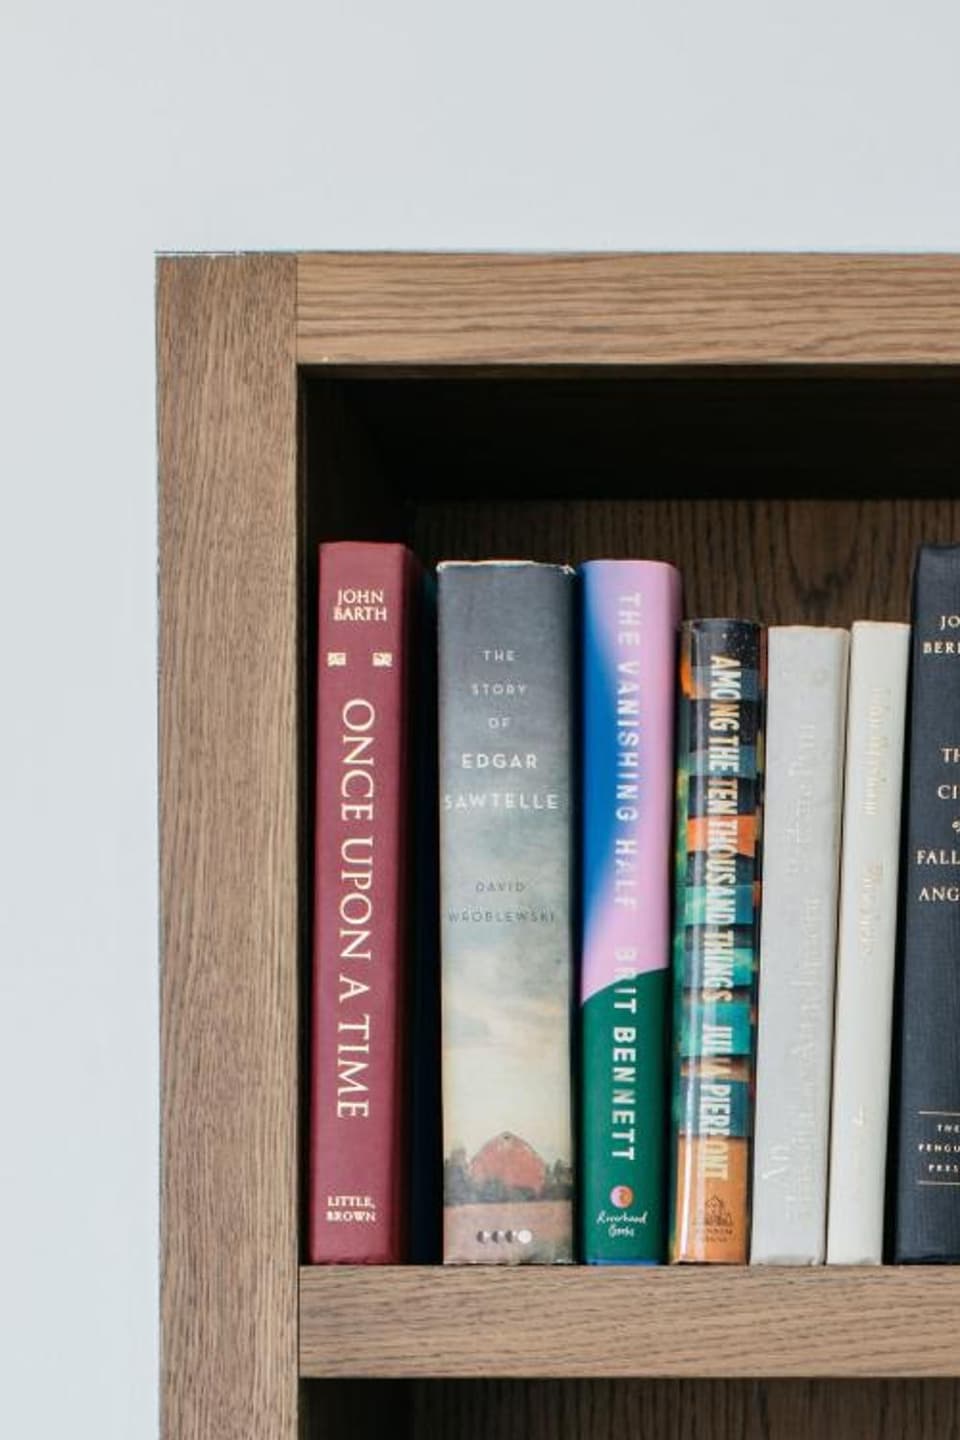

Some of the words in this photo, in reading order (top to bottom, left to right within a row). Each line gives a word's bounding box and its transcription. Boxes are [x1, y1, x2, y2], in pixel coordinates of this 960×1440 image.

[333, 606, 388, 622] BARTH
[336, 588, 385, 606] JOHN
[617, 592, 641, 647] THE
[481, 650, 516, 662] THE
[470, 683, 529, 697] STORY
[708, 655, 742, 731] AMONG
[487, 716, 513, 729] OF
[615, 661, 641, 823] VANISHING
[340, 698, 376, 821] ONCE
[460, 753, 539, 770] EDGAR
[708, 734, 739, 773] THE
[442, 793, 561, 810] SAWTELLE
[706, 779, 738, 818] TEN
[474, 880, 527, 893] DAVID
[613, 839, 638, 908] HALF
[705, 820, 738, 926] THOUSAND
[339, 837, 374, 960] UPON
[447, 910, 556, 923] WROBLEWSKI
[613, 949, 638, 1015] BRIT
[702, 930, 735, 1003] THINGS
[338, 974, 371, 1002] A
[336, 1013, 371, 1120] TIME
[699, 1023, 733, 1079] JULIA
[610, 1026, 637, 1162] BENNETT
[697, 1082, 732, 1182] PIERPONT
[936, 1123, 960, 1134] THE
[326, 1210, 377, 1223] BROWN
